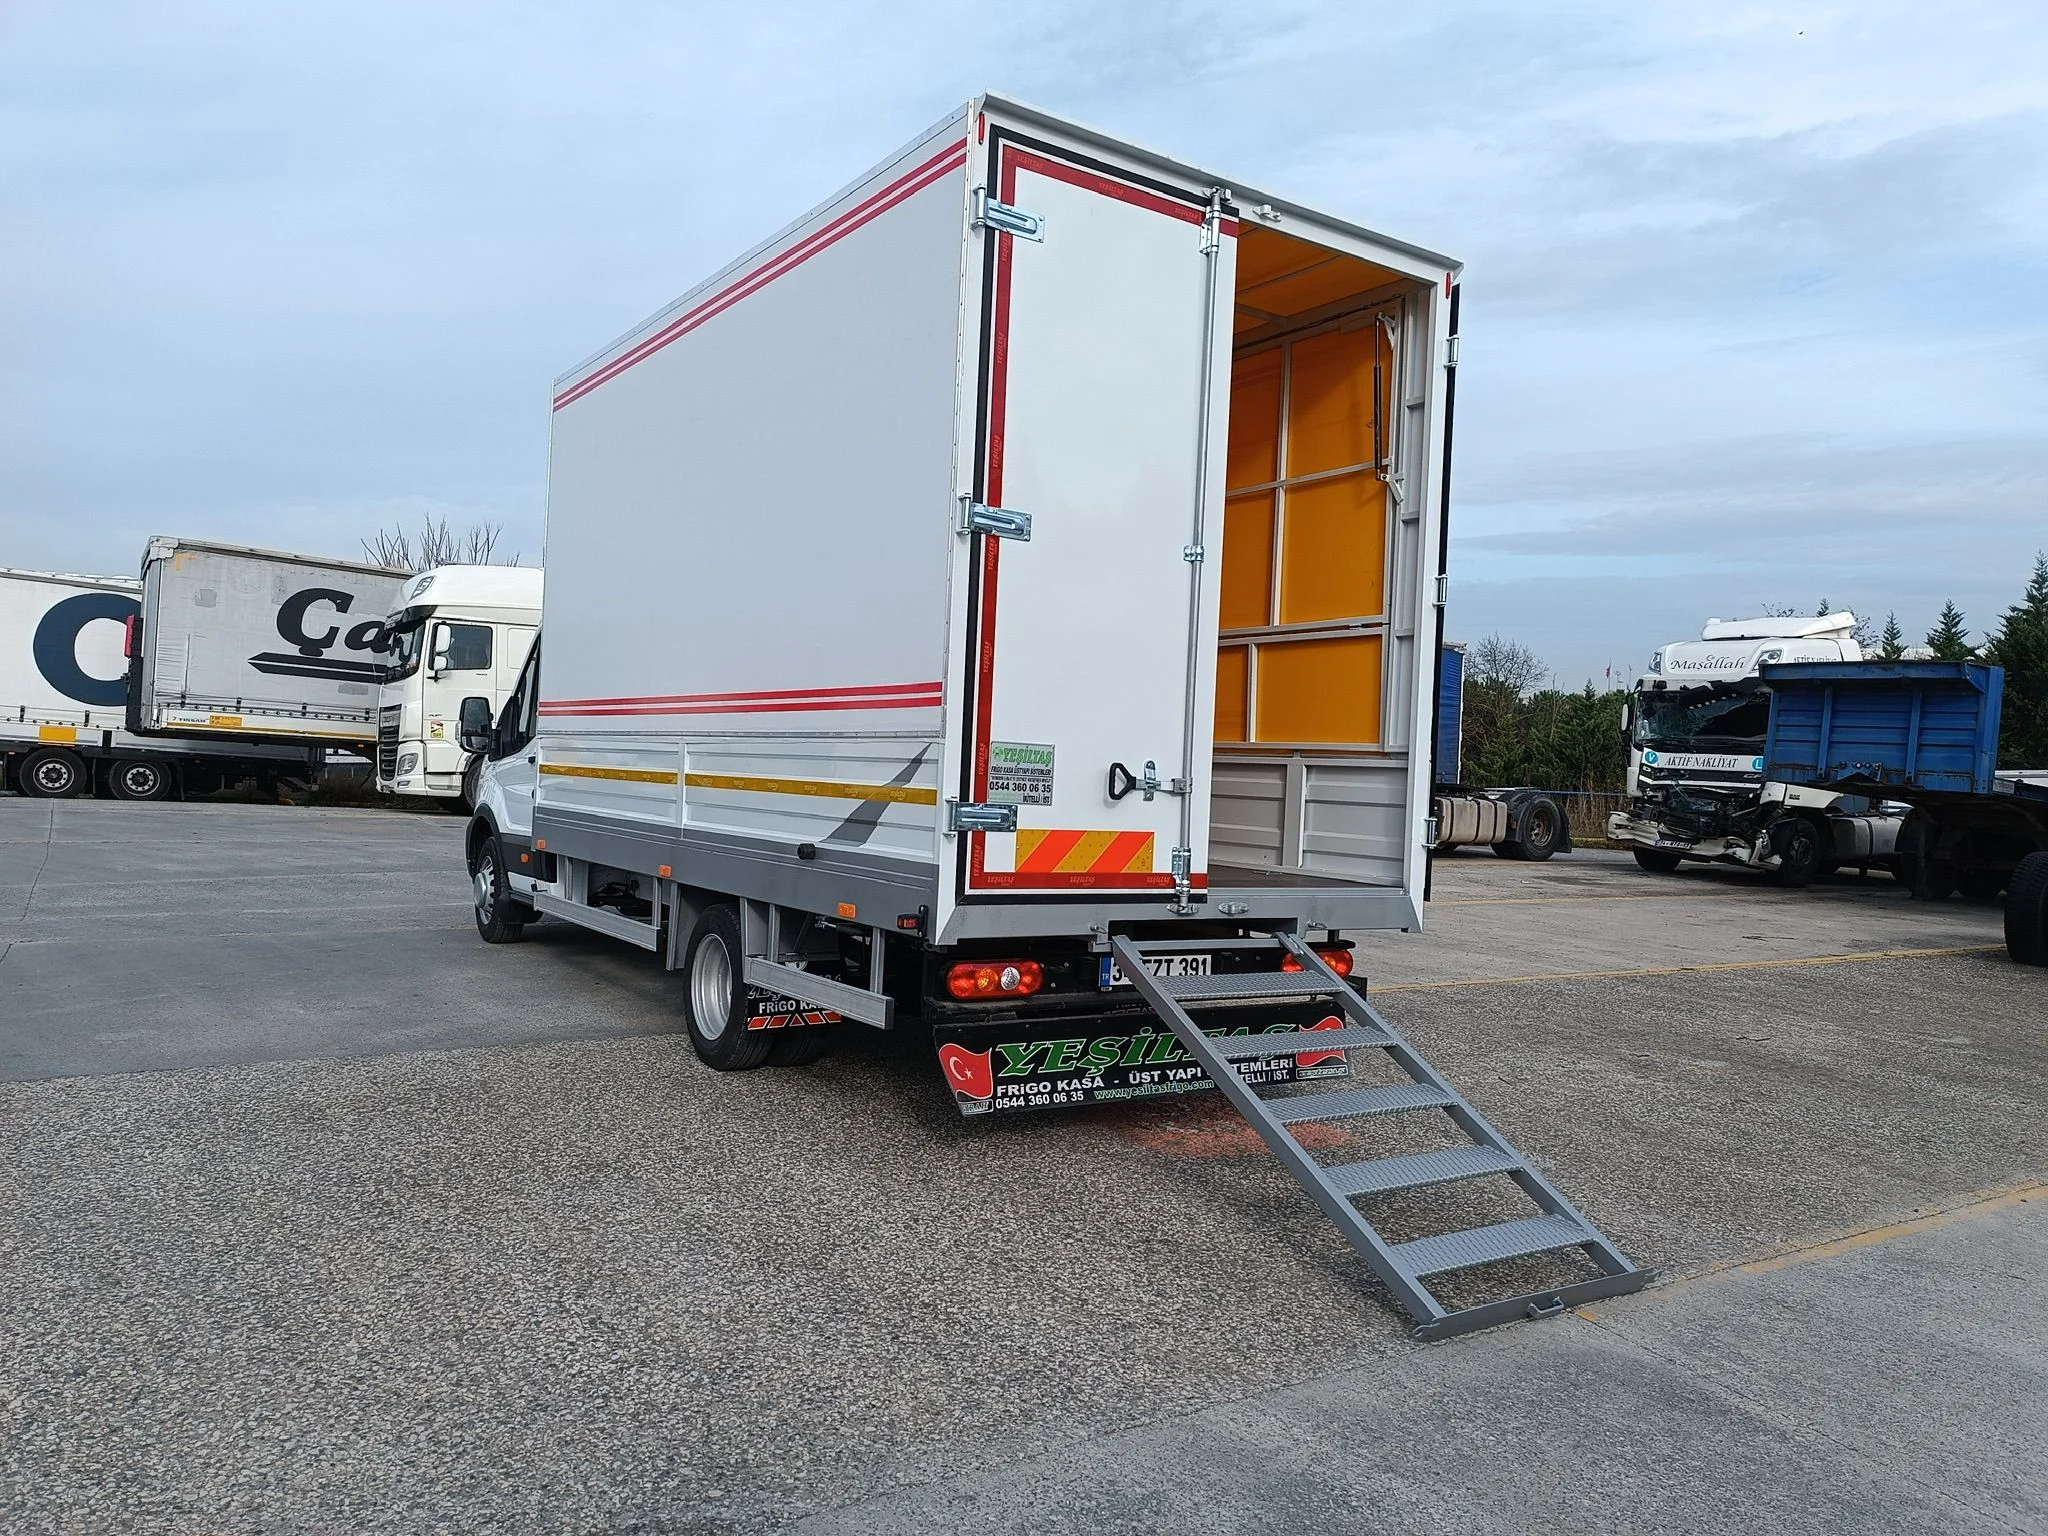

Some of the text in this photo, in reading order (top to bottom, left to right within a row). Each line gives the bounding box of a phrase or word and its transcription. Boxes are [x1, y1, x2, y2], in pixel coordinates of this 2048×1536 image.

[277, 588, 408, 660] Ça
[1003, 745, 1052, 767] YEŞİLTAŞ
[1664, 755, 1738, 768] AKTİF NAKLİYAT
[990, 781, 1051, 793] 0544 360 06 35
[1178, 957, 1208, 976] 391
[995, 1023, 1297, 1077] YEŞİL
[1057, 1076, 1105, 1092] KASA
[1128, 1070, 1161, 1084] ÜST
[1165, 1067, 1202, 1081] YAPI
[1094, 1079, 1215, 1099] www.yesiltasfrigo.com
[995, 1090, 1084, 1109] 0544 360 06 35
